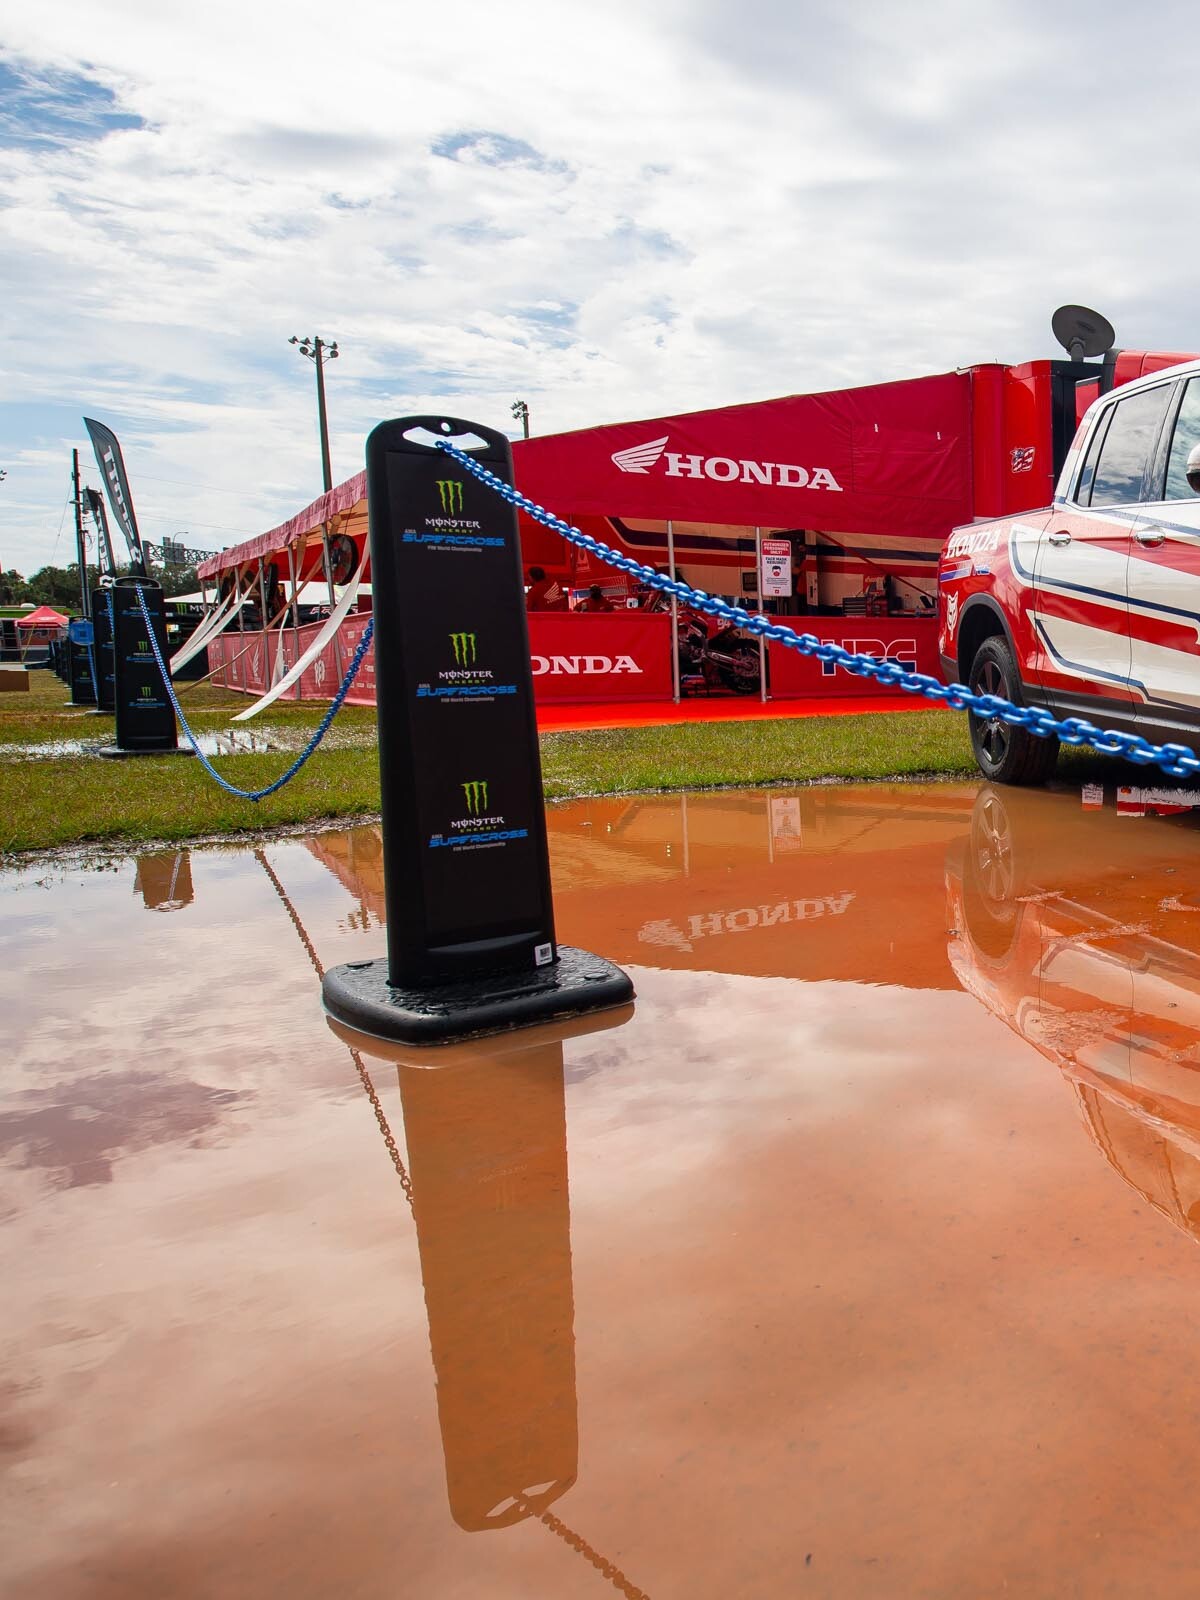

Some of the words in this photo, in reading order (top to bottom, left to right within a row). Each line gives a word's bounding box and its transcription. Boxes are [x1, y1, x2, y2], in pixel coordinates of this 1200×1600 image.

[664, 452, 843, 492] HONDA
[425, 517, 481, 529] MONSTER
[402, 532, 505, 547] SUPERCROSS
[945, 530, 1001, 559] HONDA
[530, 655, 643, 675] ONDA
[439, 669, 494, 679] MONSTER
[416, 685, 518, 697] SUPERCROSS
[451, 816, 505, 829] MONSTER
[429, 829, 529, 848] SUPERCROSS
